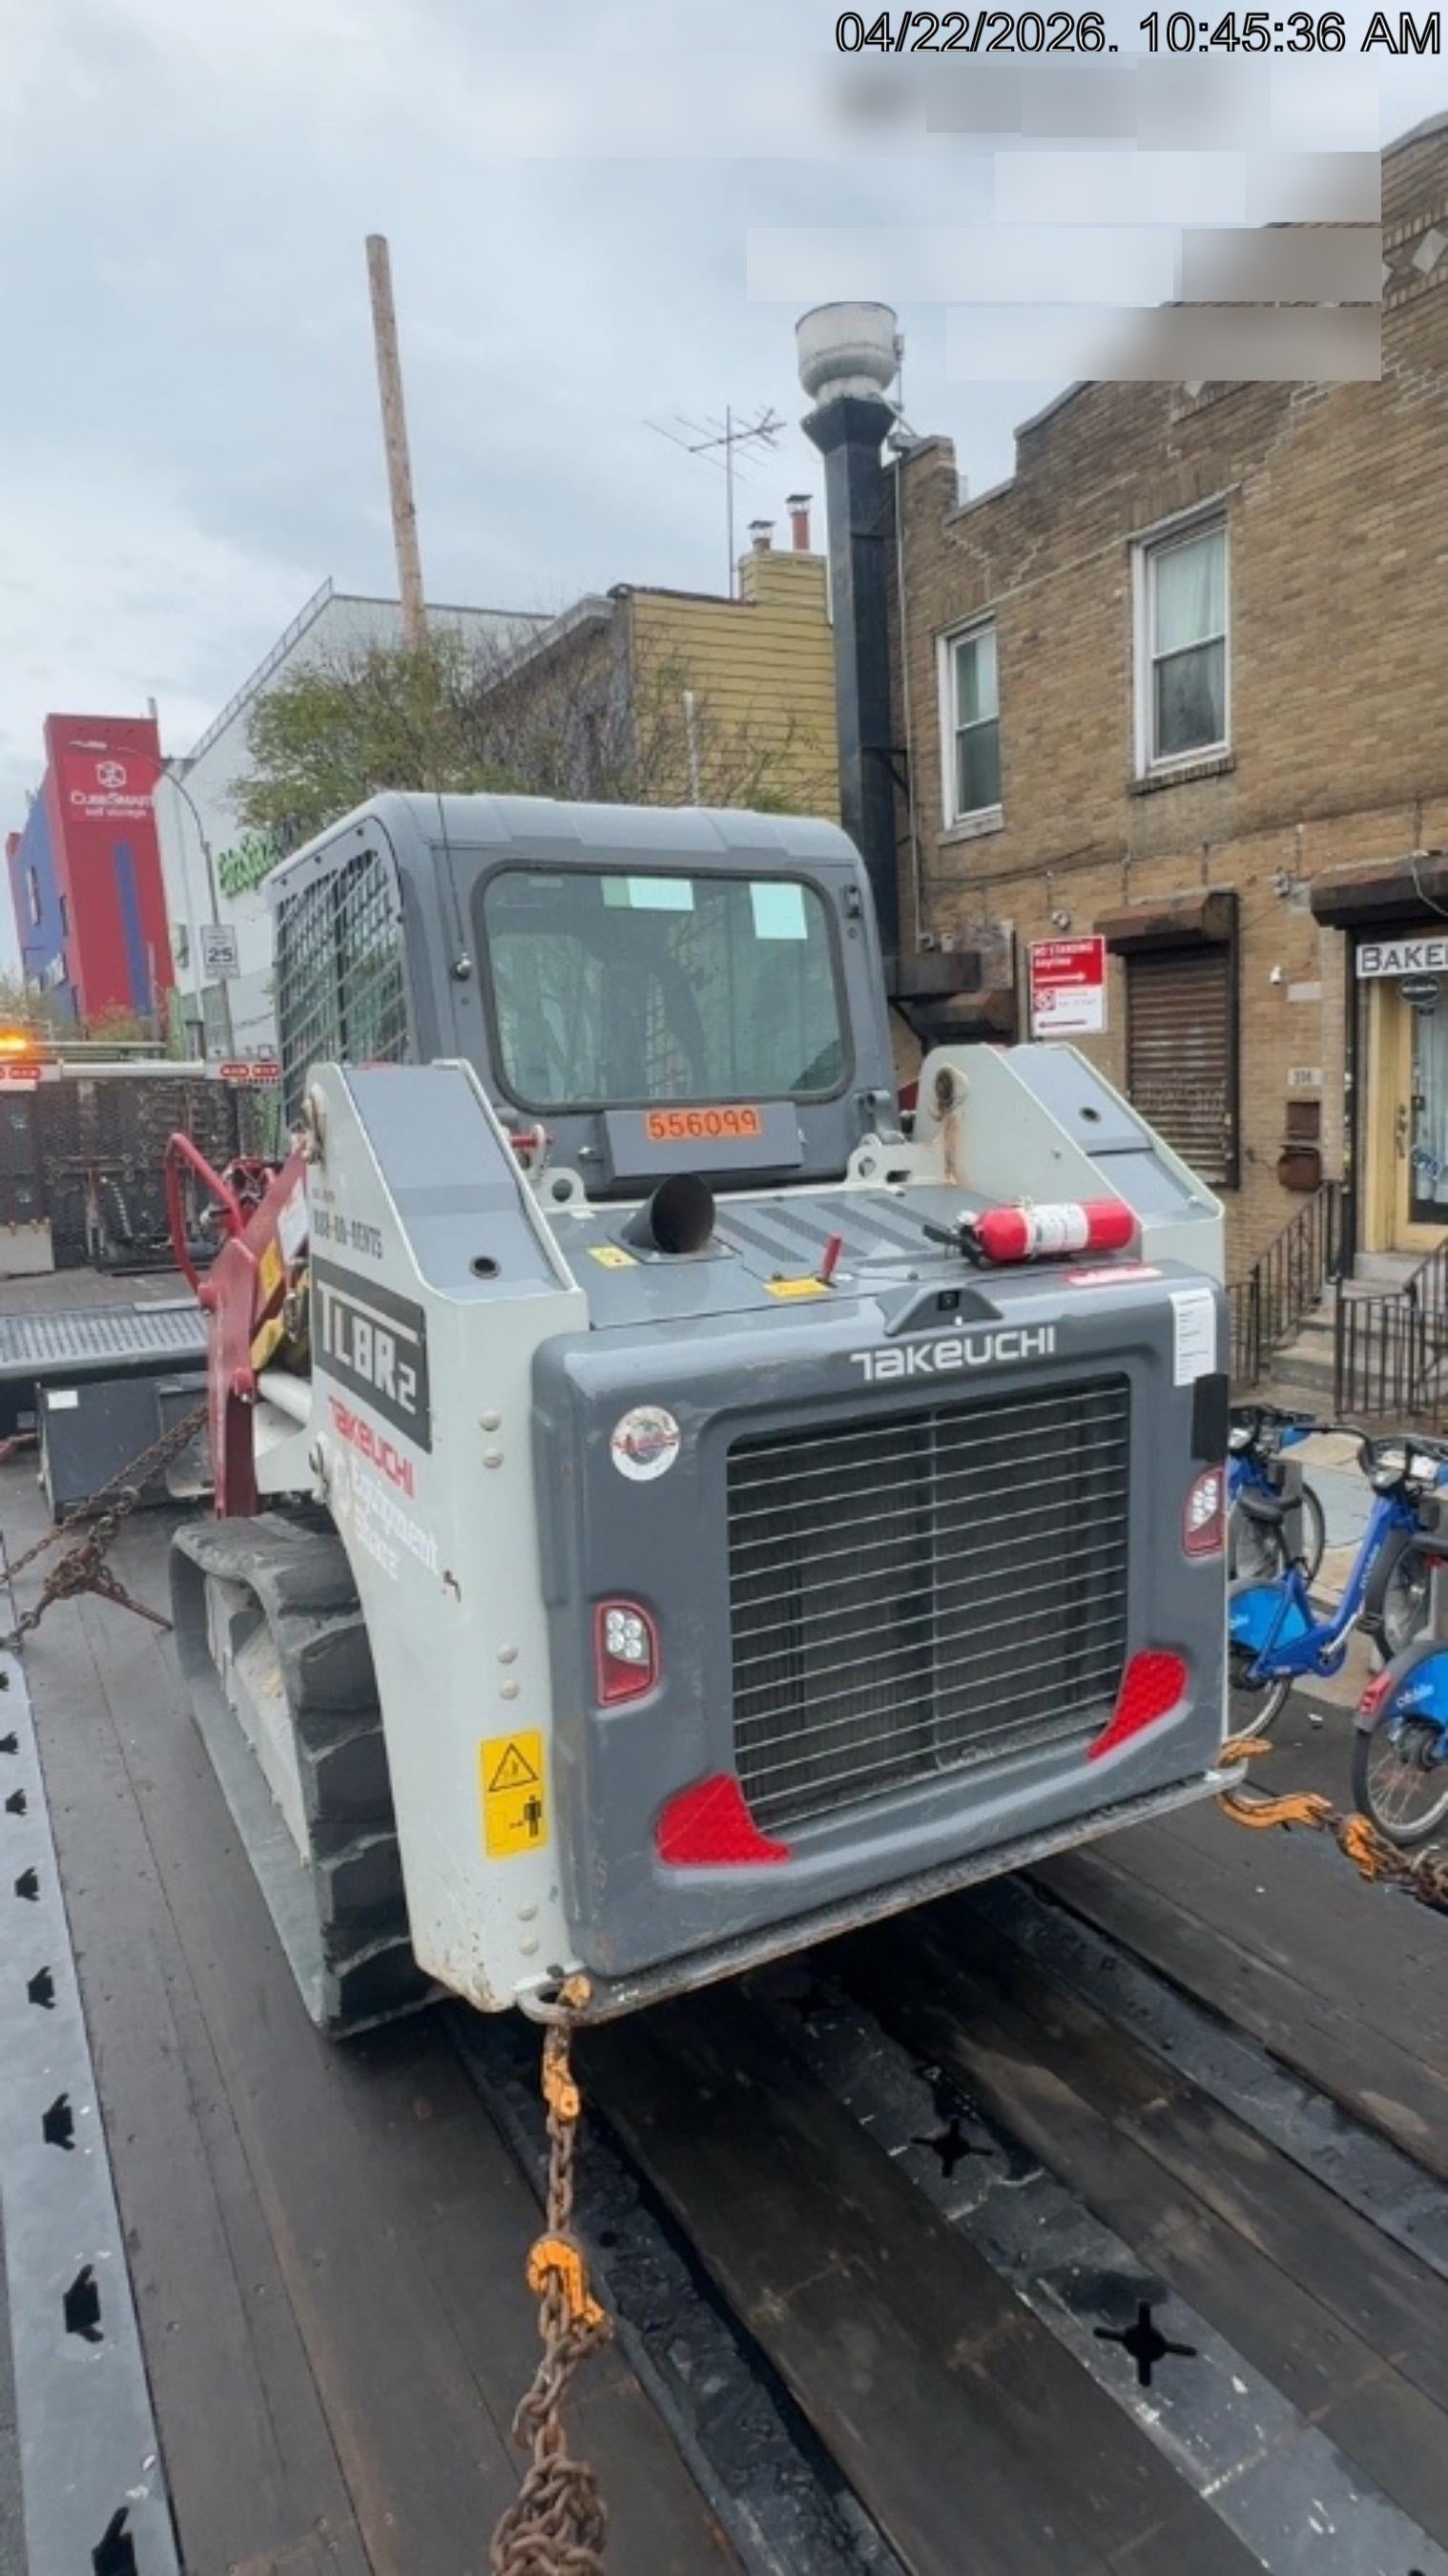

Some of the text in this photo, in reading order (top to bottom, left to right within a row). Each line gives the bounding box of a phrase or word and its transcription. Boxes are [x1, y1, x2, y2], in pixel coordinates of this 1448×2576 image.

[208, 946, 233, 963] 25
[1049, 942, 1094, 955] STANDING
[1362, 943, 1448, 971] BAKE
[649, 1109, 757, 1140] 556099
[850, 1324, 1055, 1381] TAKEUCHI
[327, 1394, 416, 1501] TAKEUCHI
